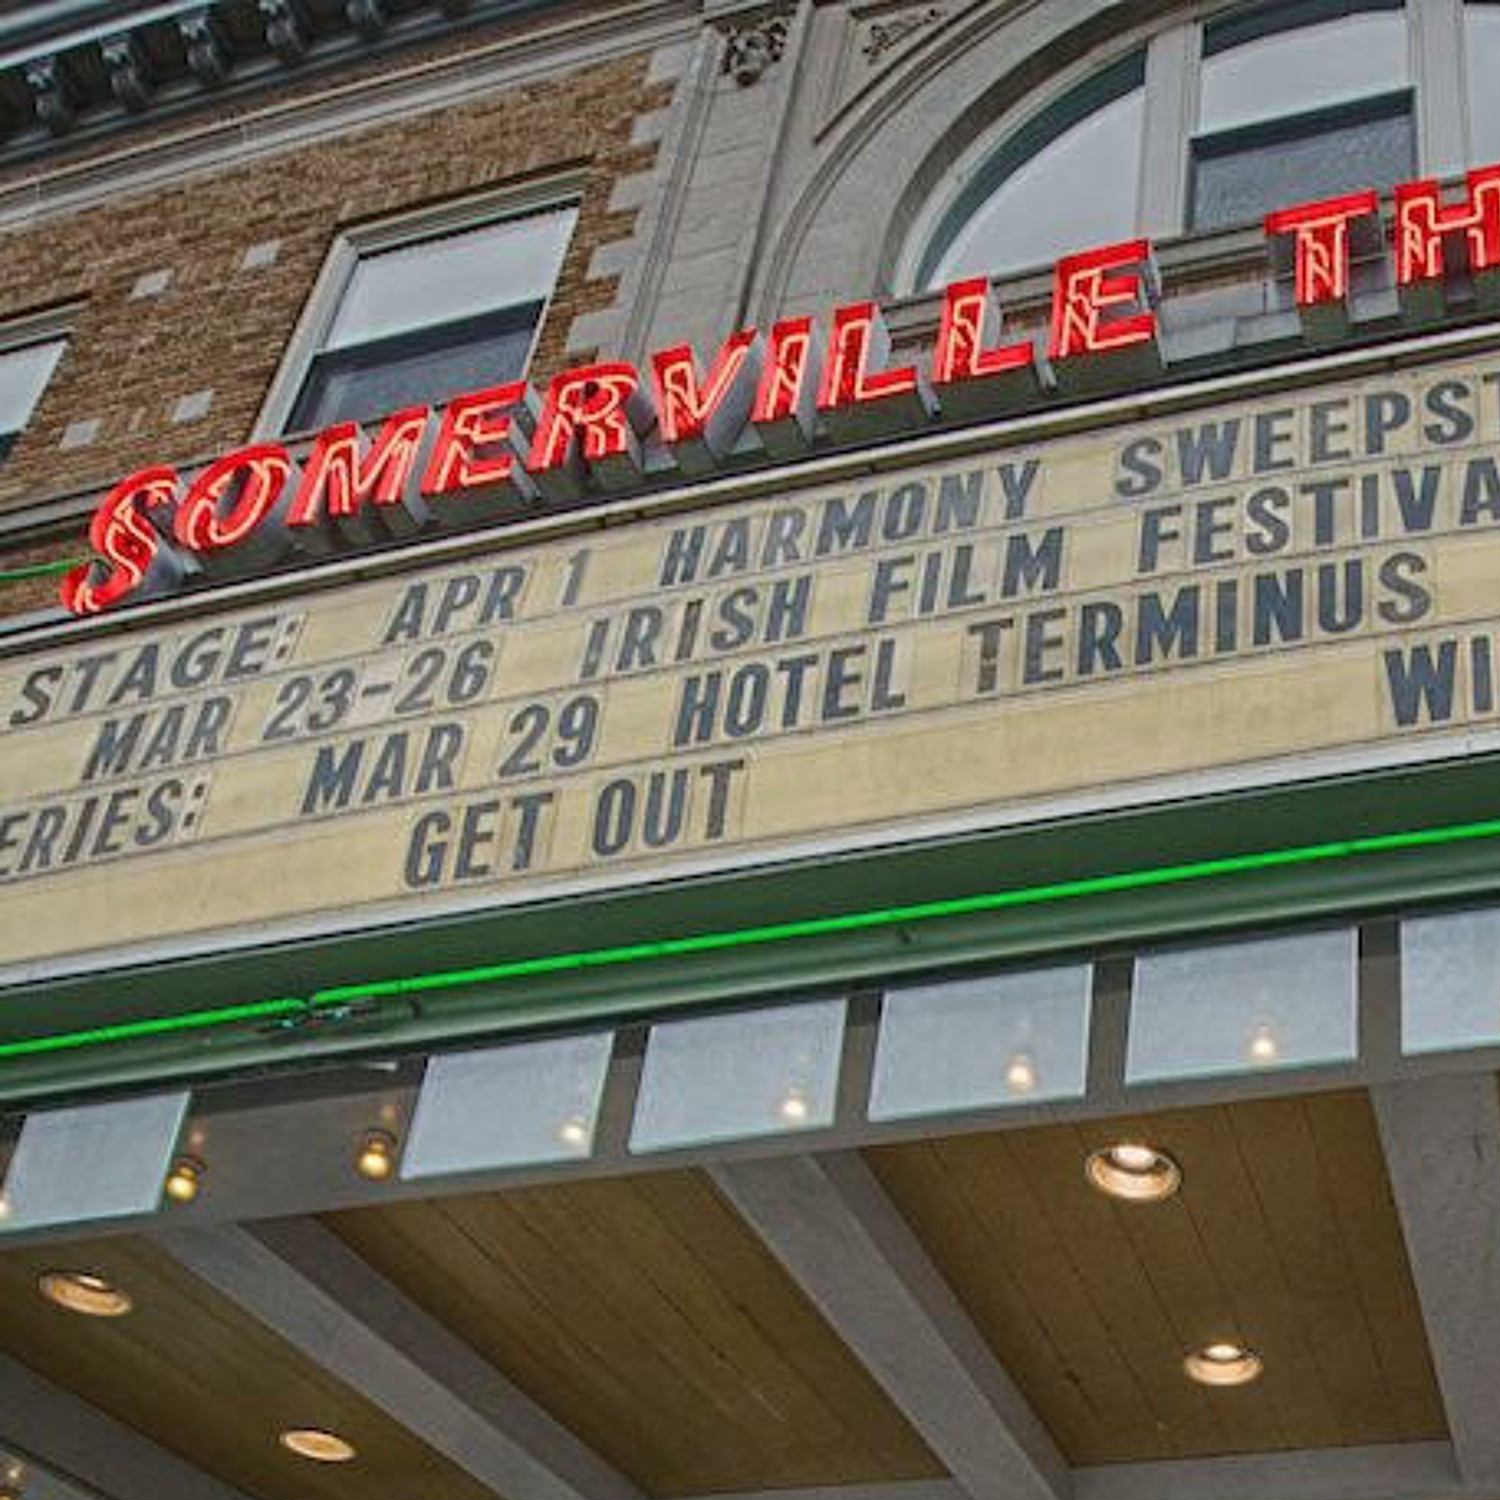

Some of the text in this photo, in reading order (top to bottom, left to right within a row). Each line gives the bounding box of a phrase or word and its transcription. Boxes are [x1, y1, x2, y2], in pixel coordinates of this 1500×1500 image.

[60, 238, 1156, 615] SOMERVILLE
[9, 615, 302, 727] STAGE:
[380, 567, 524, 645] APR
[561, 549, 592, 606] 1
[661, 459, 1041, 586] HARMONY
[81, 697, 232, 781] MAR
[262, 639, 494, 741] 23-26
[578, 574, 812, 679] IRISH
[867, 526, 1064, 622] FILM
[301, 722, 464, 814] MAR
[500, 695, 600, 777] 29
[674, 638, 906, 747] HOTEL
[968, 551, 1432, 693] TERMINUS
[403, 790, 553, 890] GET
[590, 758, 745, 857] OUT
